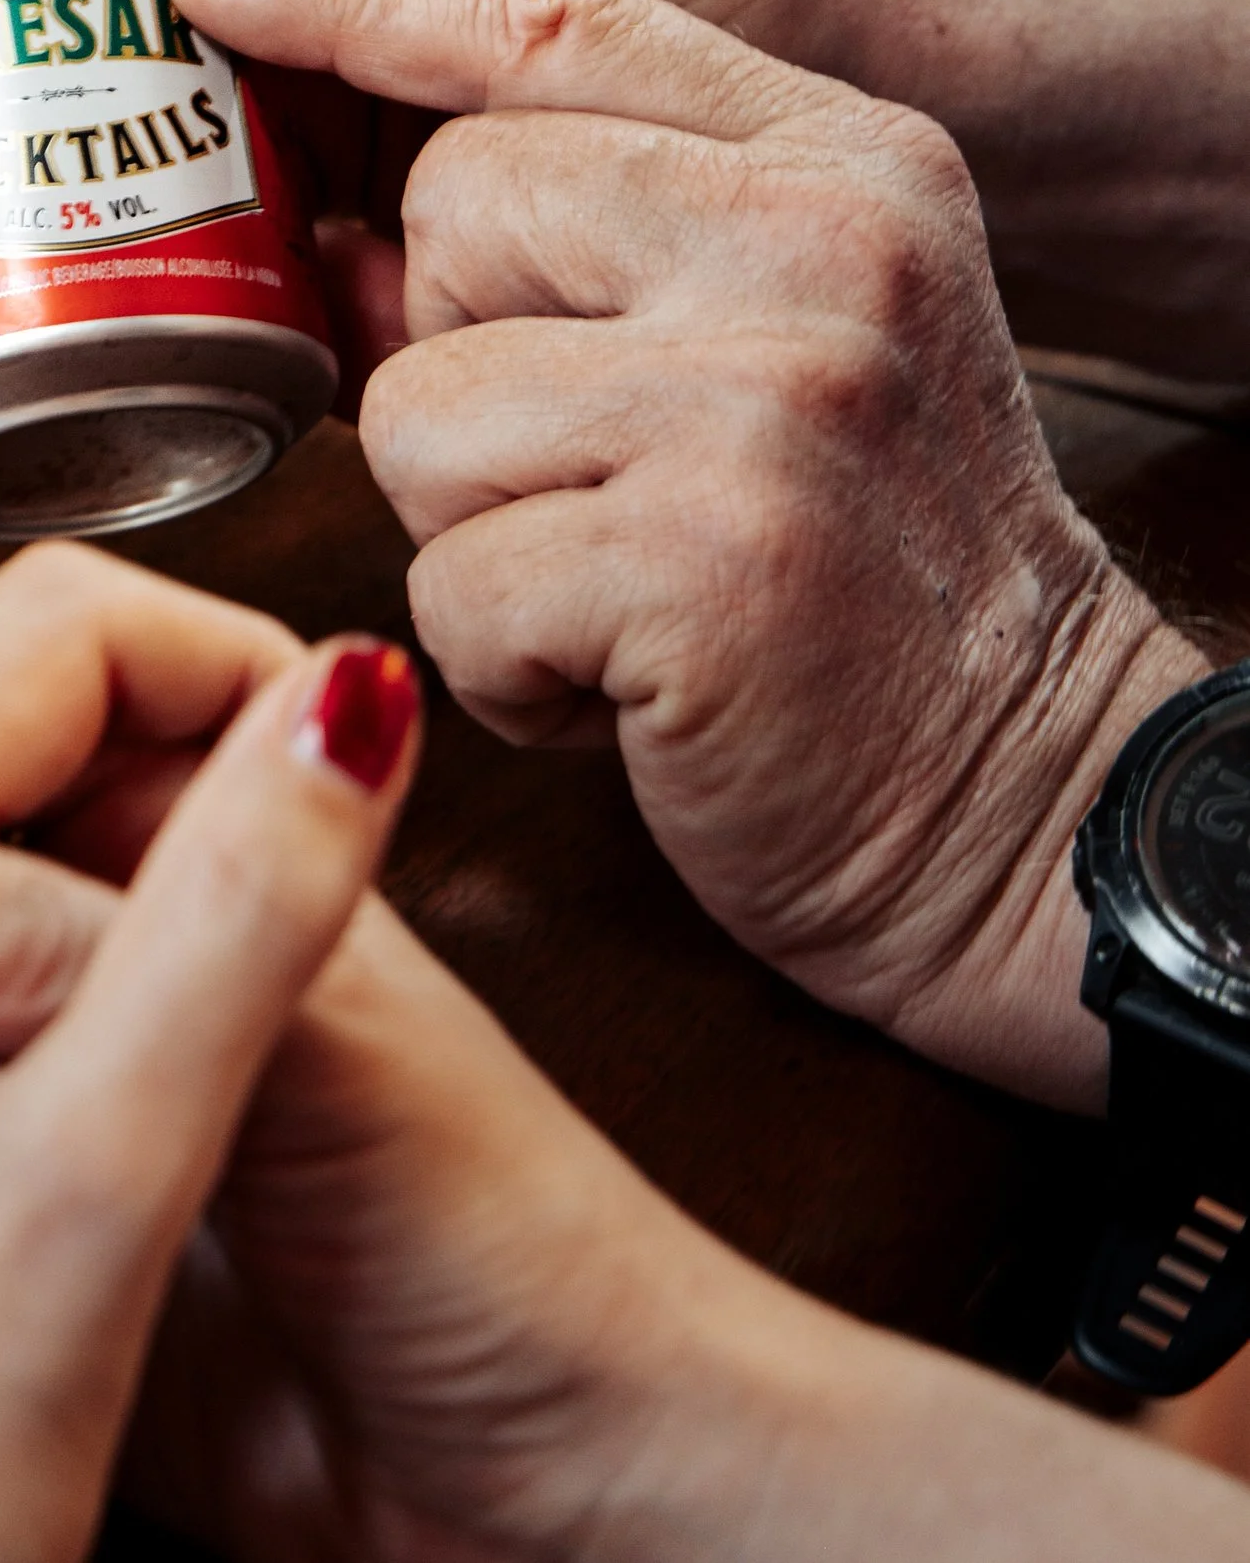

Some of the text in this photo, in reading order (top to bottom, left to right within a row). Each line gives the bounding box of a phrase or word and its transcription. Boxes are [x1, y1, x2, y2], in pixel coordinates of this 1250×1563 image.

[5, 193, 159, 231] ALC. 5% VOL.
